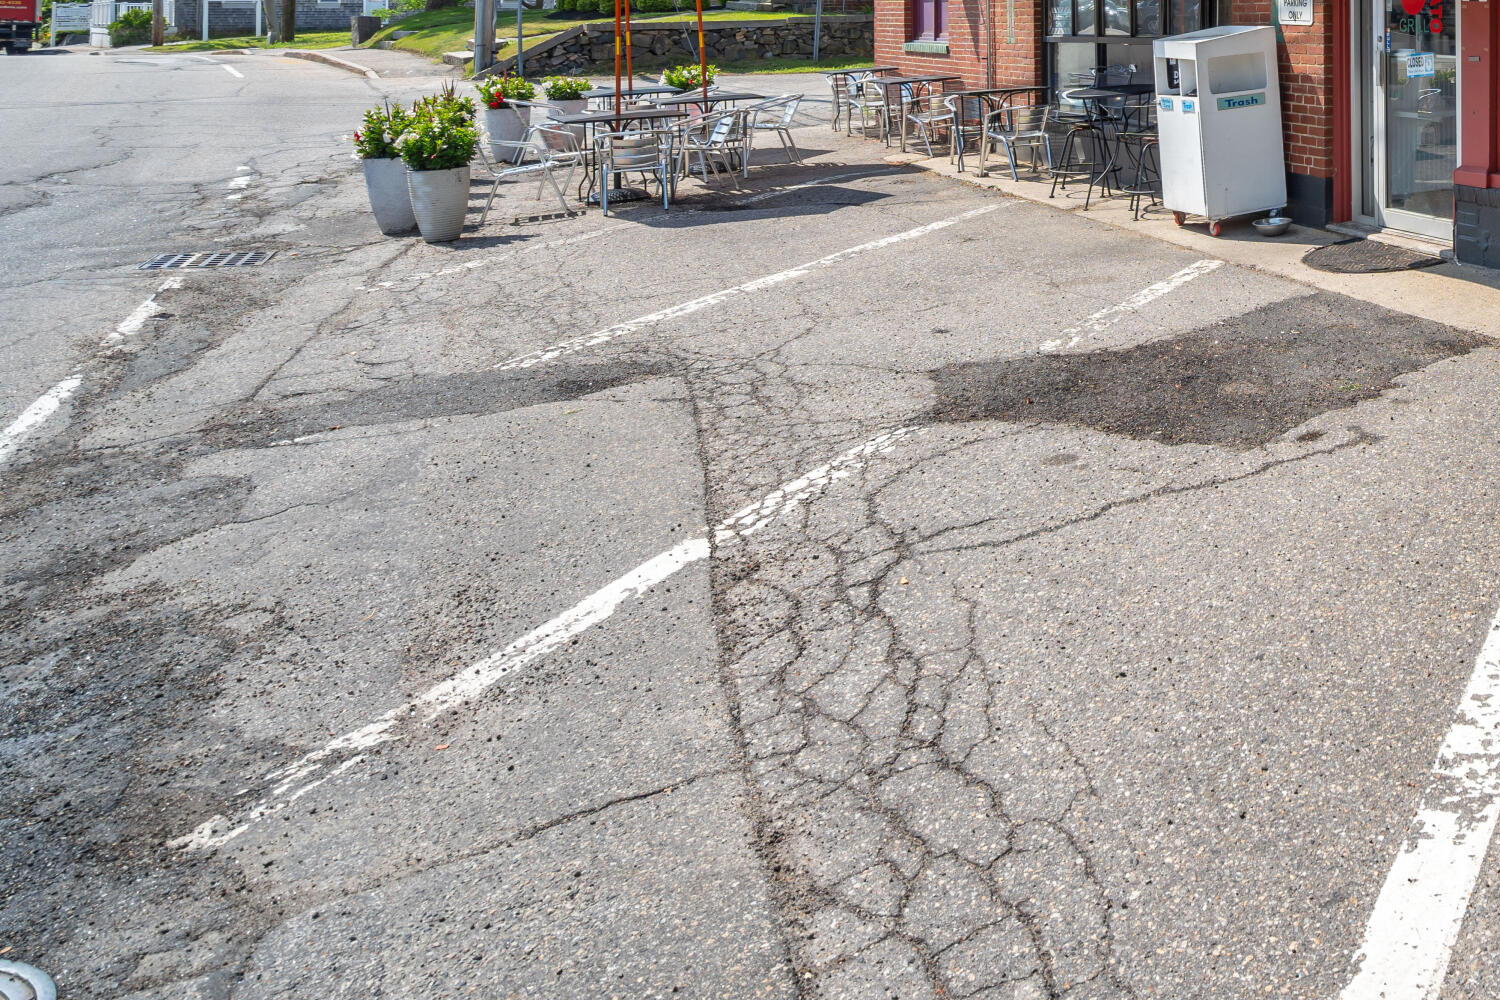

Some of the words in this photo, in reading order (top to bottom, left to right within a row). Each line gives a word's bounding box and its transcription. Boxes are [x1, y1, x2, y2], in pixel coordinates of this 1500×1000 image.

[1288, 10, 1303, 20] ONLY
[1400, 18, 1430, 33] GRILL
[1225, 96, 1258, 108] Trash
